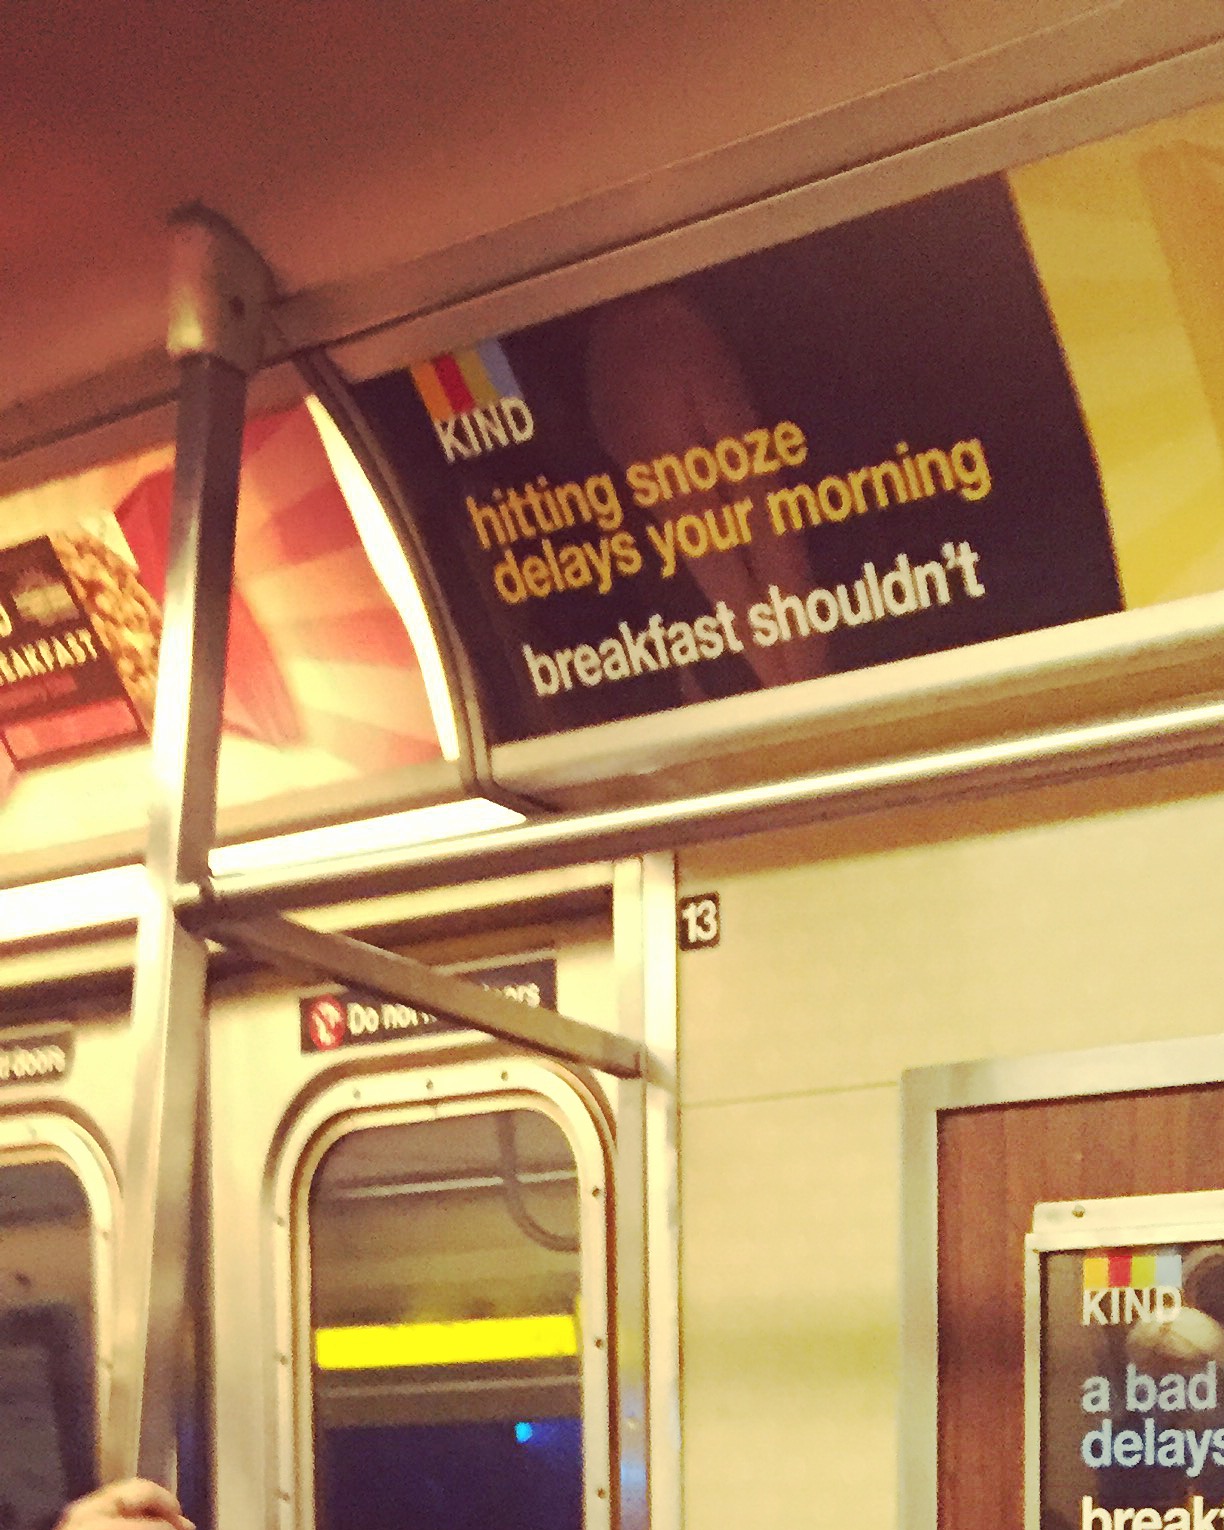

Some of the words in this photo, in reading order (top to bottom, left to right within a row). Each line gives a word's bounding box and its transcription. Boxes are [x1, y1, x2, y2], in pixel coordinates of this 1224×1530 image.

[433, 395, 537, 463] KIND
[467, 468, 624, 550] hitting
[624, 419, 809, 508] snooze
[492, 527, 643, 605] delays
[647, 494, 756, 579] your
[767, 436, 994, 536] morning
[523, 605, 744, 698] breakfast
[750, 539, 986, 649] shouldn't
[682, 900, 717, 942] 13
[347, 1002, 379, 1036] Do
[1081, 1285, 1183, 1325] KIND
[1081, 1374, 1111, 1413] a
[1126, 1360, 1218, 1412] bad
